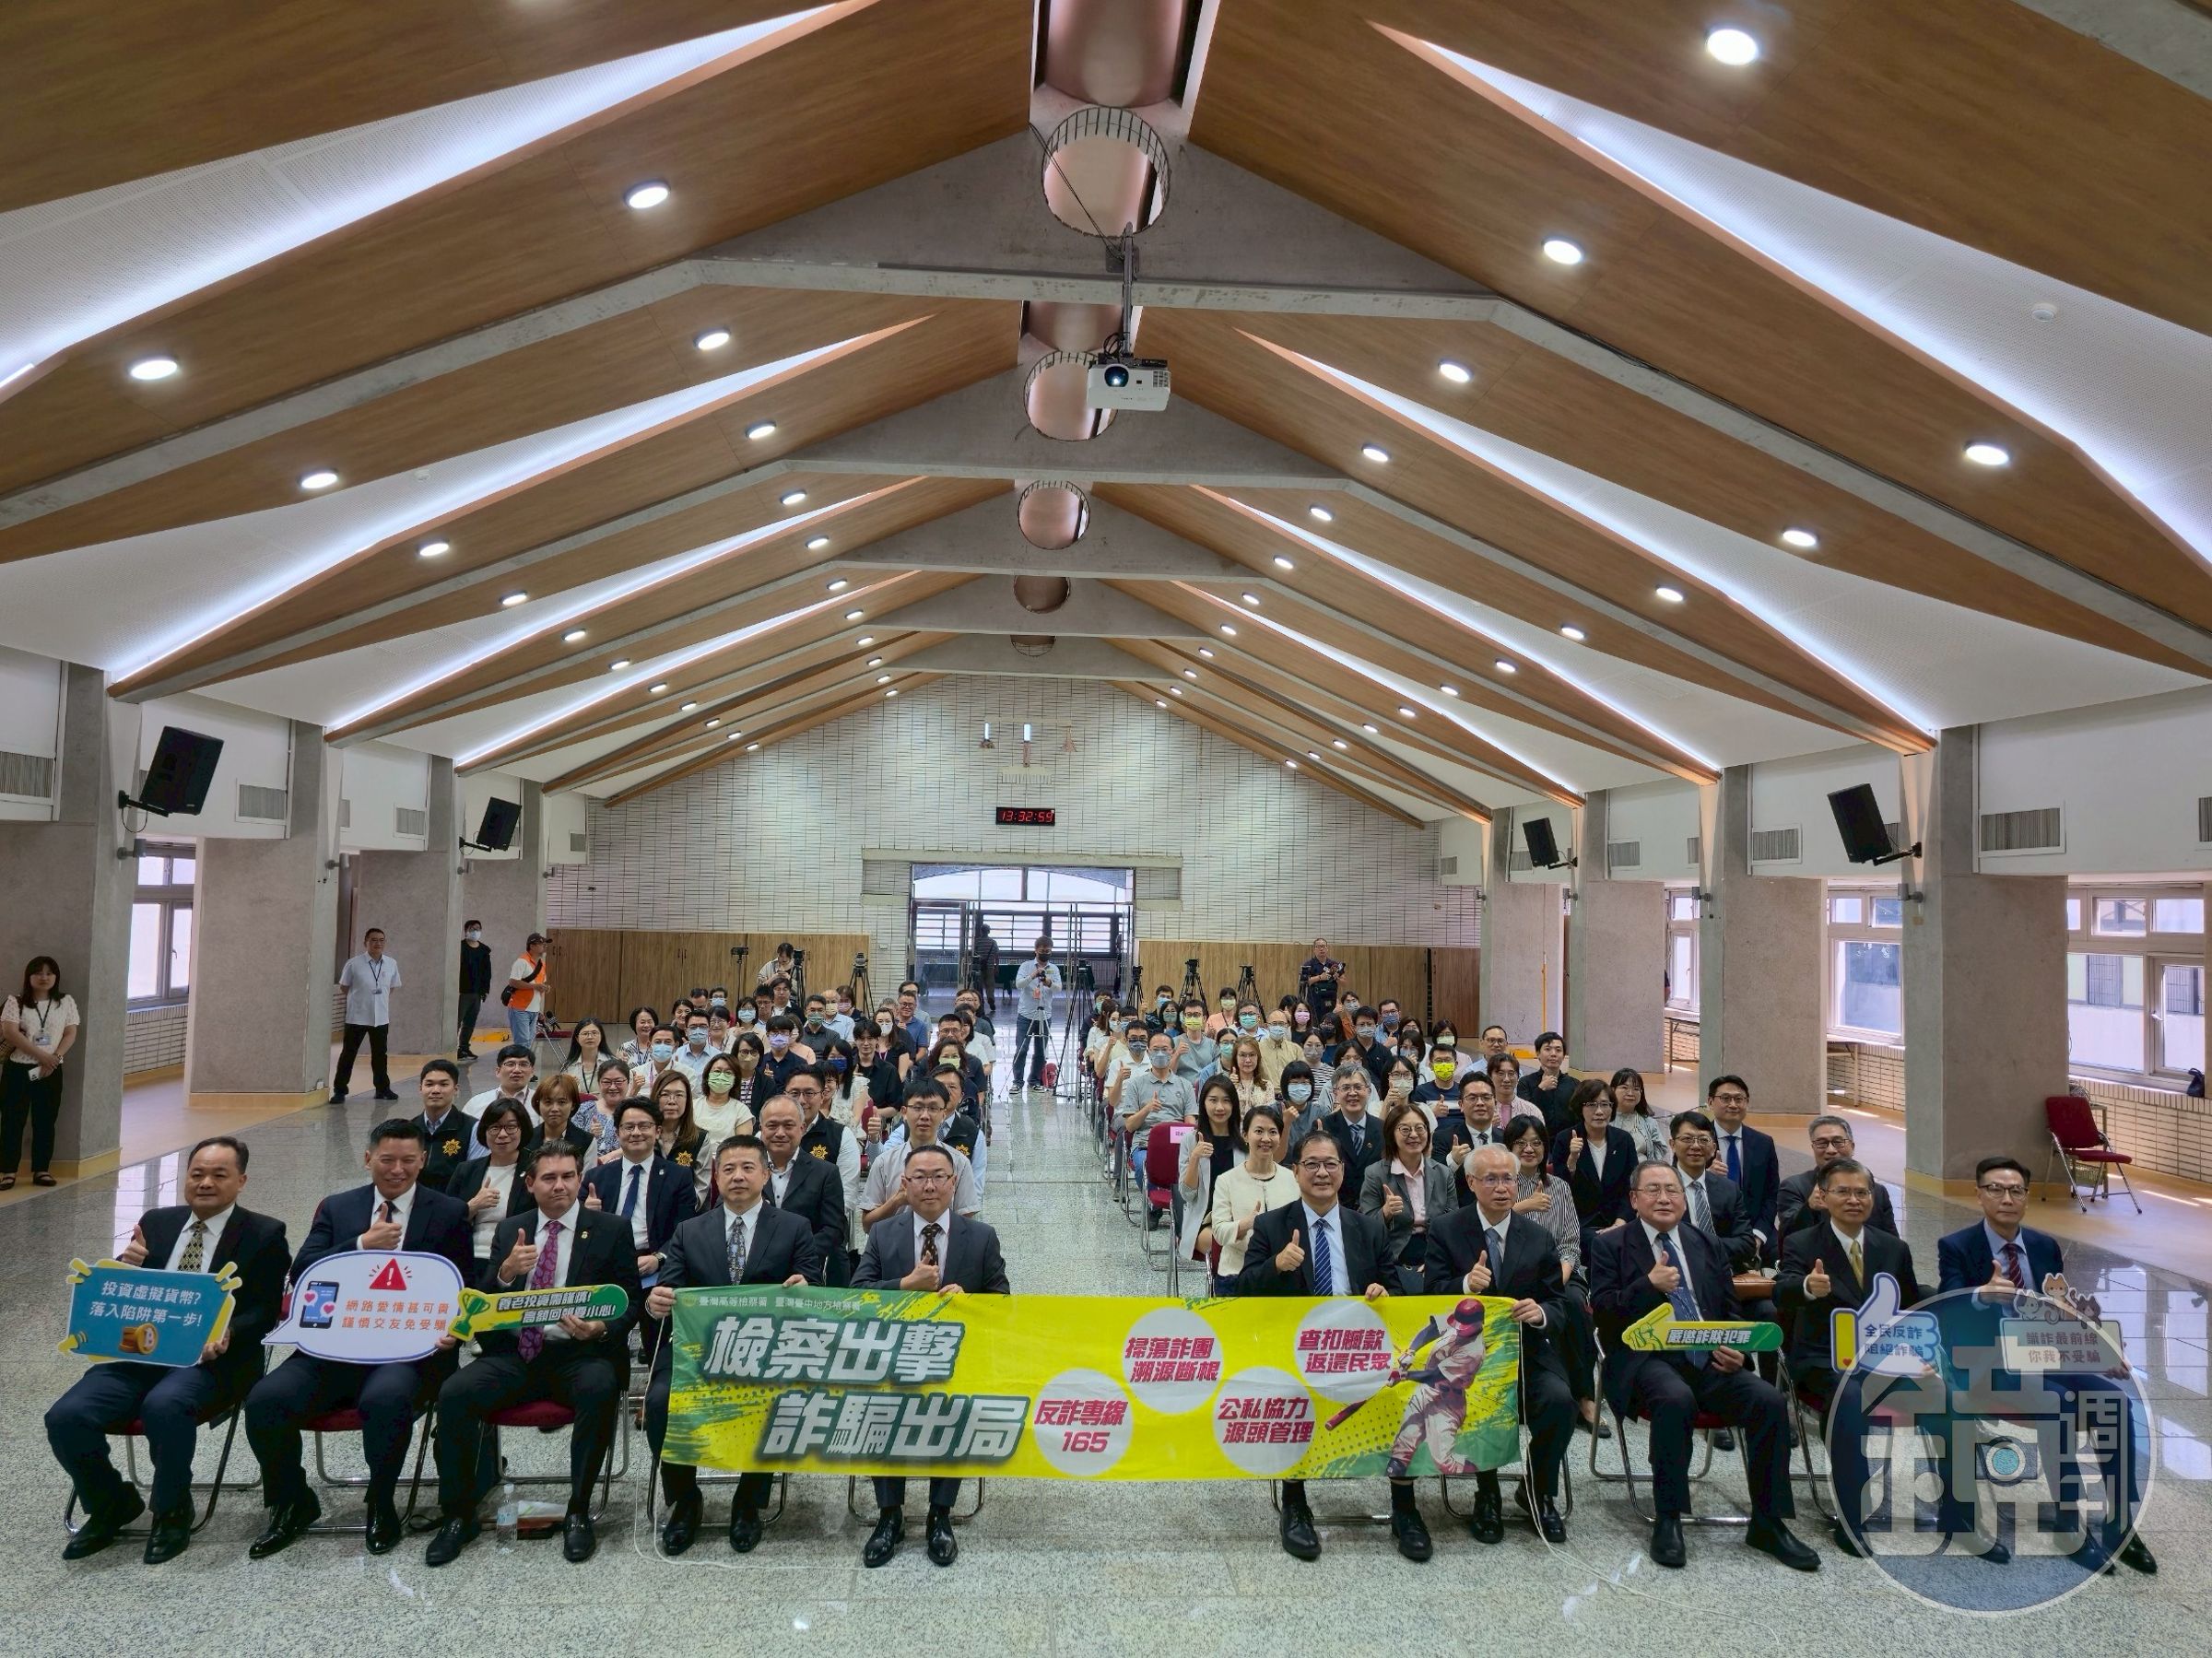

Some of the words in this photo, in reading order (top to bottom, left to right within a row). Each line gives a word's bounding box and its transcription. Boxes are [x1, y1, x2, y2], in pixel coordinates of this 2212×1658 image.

[1002, 811, 1053, 822] 13:32:59
[101, 1280, 202, 1306] 投資虛擬貨幣?
[89, 1301, 203, 1327] 落入陷阱第一步!
[346, 1299, 450, 1314] 網路愛情甚可貴
[342, 1316, 448, 1332] 謹慎交友免受騙
[1865, 1323, 1923, 1339] 全民反詐
[1667, 1329, 1752, 1344] 嚴懲詐欺犯罪
[2026, 1332, 2099, 1346] 識詐最前線
[703, 1315, 964, 1382] 檢察出擊
[1124, 1337, 1215, 1359] 掃蕩詐團
[2028, 1349, 2100, 1363] 你我不受騙
[1129, 1360, 1221, 1382] 溯源斷根
[1304, 1352, 1392, 1373] 返還民眾
[1034, 1399, 1129, 1426] 反詐專線
[1218, 1397, 1310, 1420] 公私協力
[761, 1393, 1029, 1458] 詐騙出局
[1223, 1420, 1315, 1444] 源頭管理
[1062, 1431, 1111, 1453] 165
